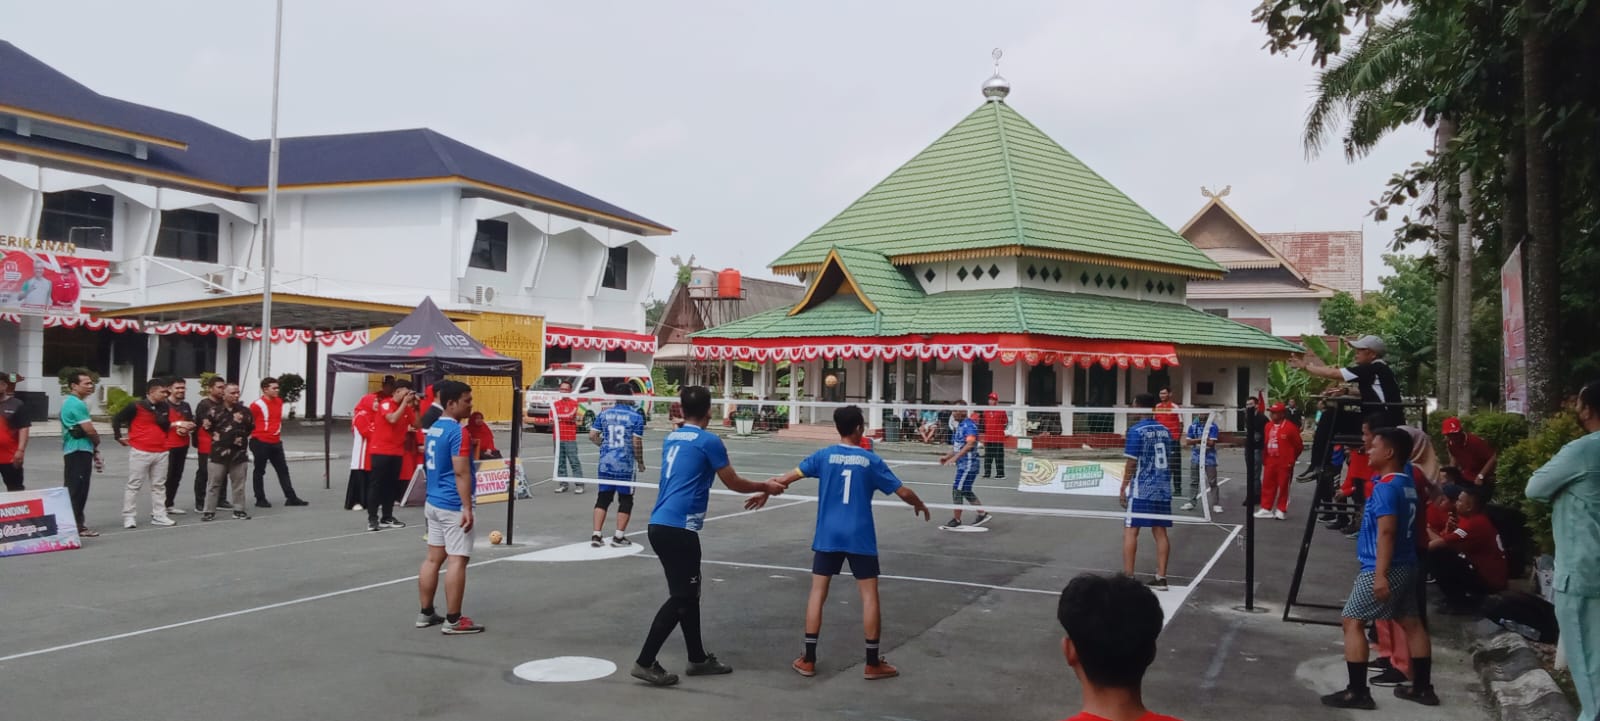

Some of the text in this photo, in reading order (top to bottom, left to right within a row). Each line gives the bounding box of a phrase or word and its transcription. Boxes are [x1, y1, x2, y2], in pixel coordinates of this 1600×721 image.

[608, 425, 625, 448] 13
[666, 445, 681, 479] 4
[1154, 442, 1168, 469] 8
[475, 481, 506, 492] TIVITAS
[840, 469, 852, 504] 1
[0, 504, 31, 518] ANDING
